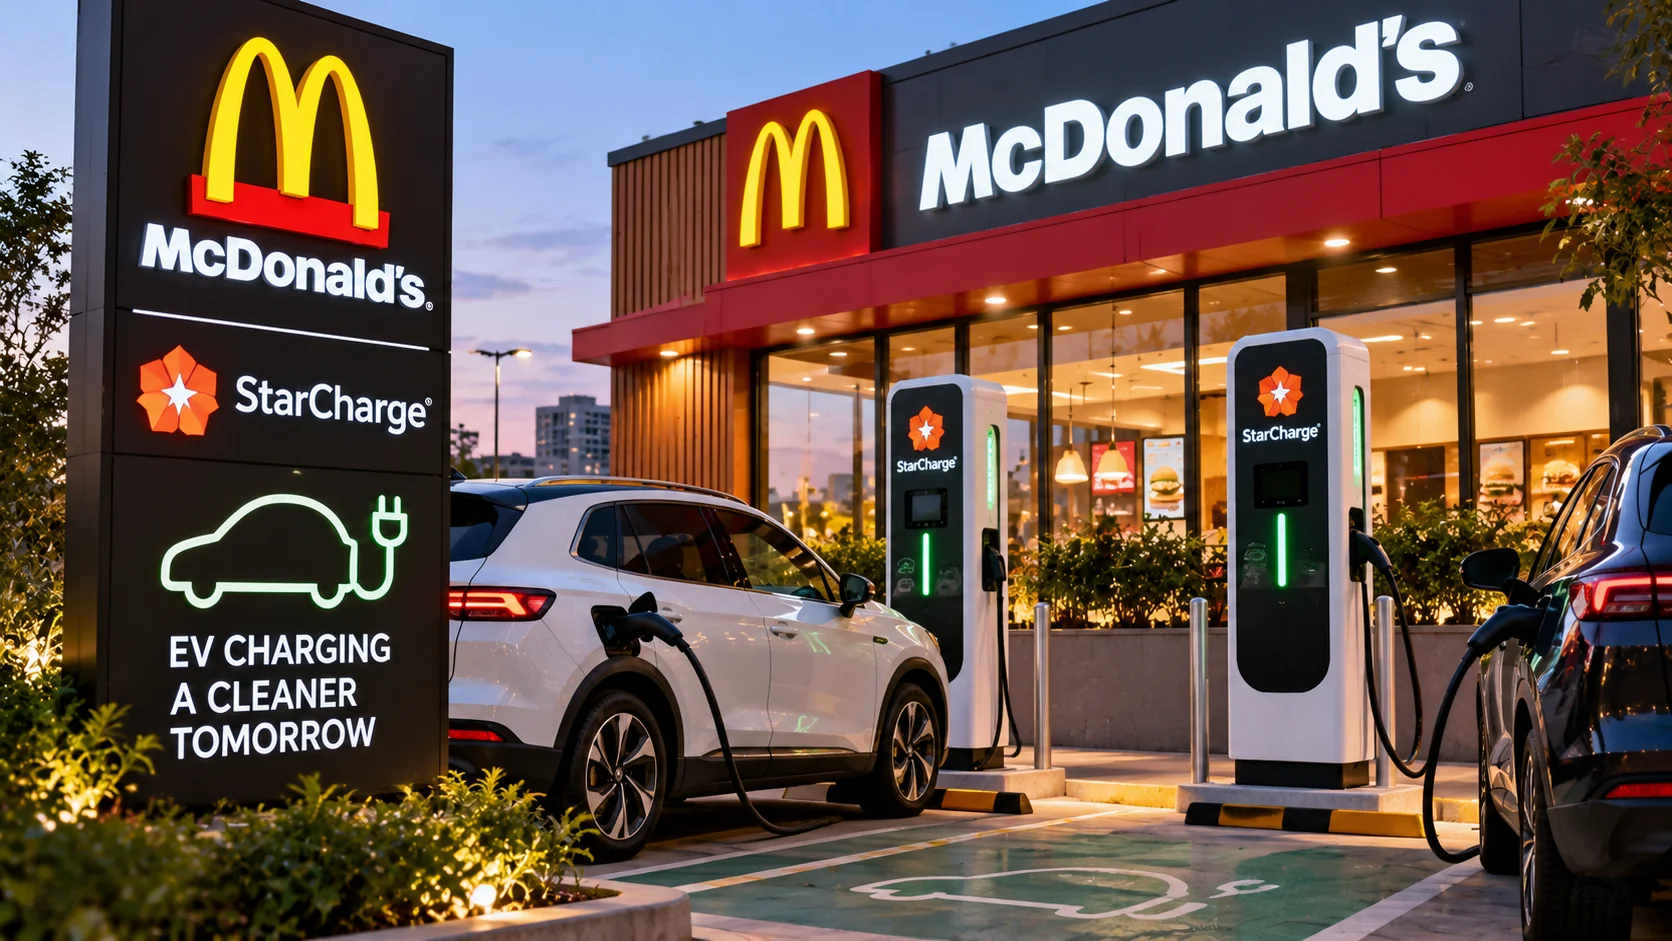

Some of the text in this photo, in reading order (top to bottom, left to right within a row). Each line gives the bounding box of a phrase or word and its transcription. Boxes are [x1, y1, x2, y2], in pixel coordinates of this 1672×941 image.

[170, 633, 391, 668] EV CHARGING
[170, 678, 358, 716] A CLEANER
[170, 716, 377, 760] TOMORROW
